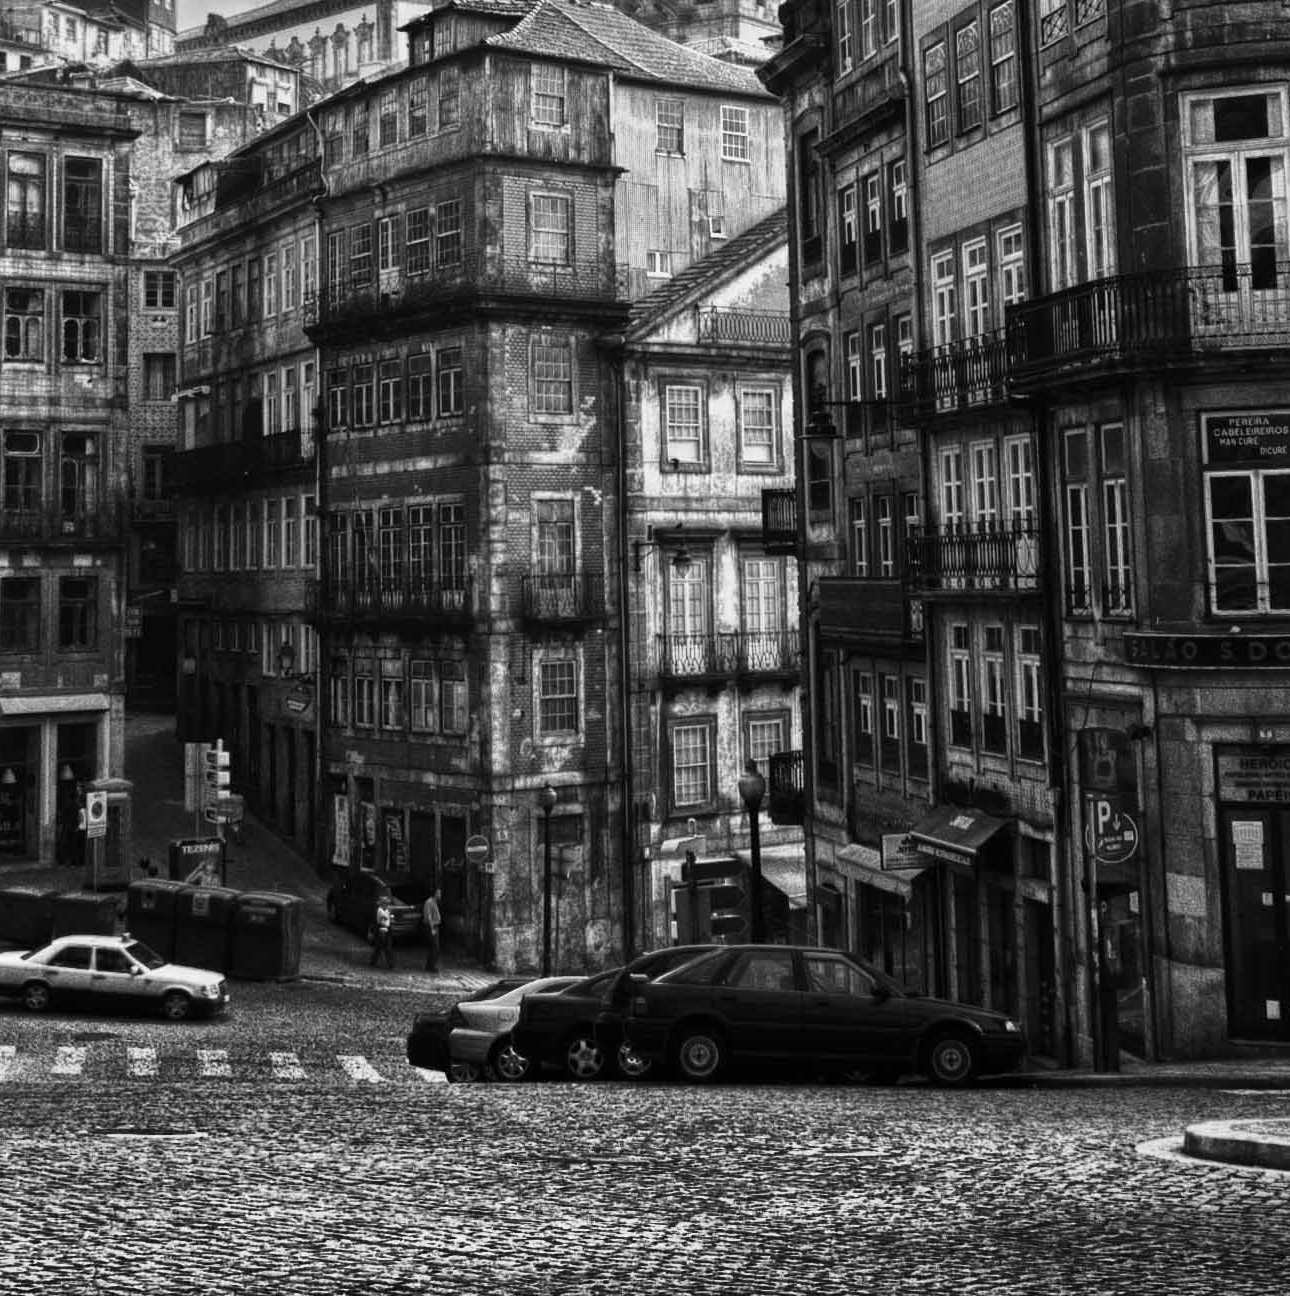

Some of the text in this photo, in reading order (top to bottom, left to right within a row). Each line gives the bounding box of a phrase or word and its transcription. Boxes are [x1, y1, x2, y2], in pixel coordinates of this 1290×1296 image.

[1228, 416, 1270, 426] PEREIRA
[1212, 426, 1290, 437] CABELEIREIROS
[1097, 800, 1112, 835] P
